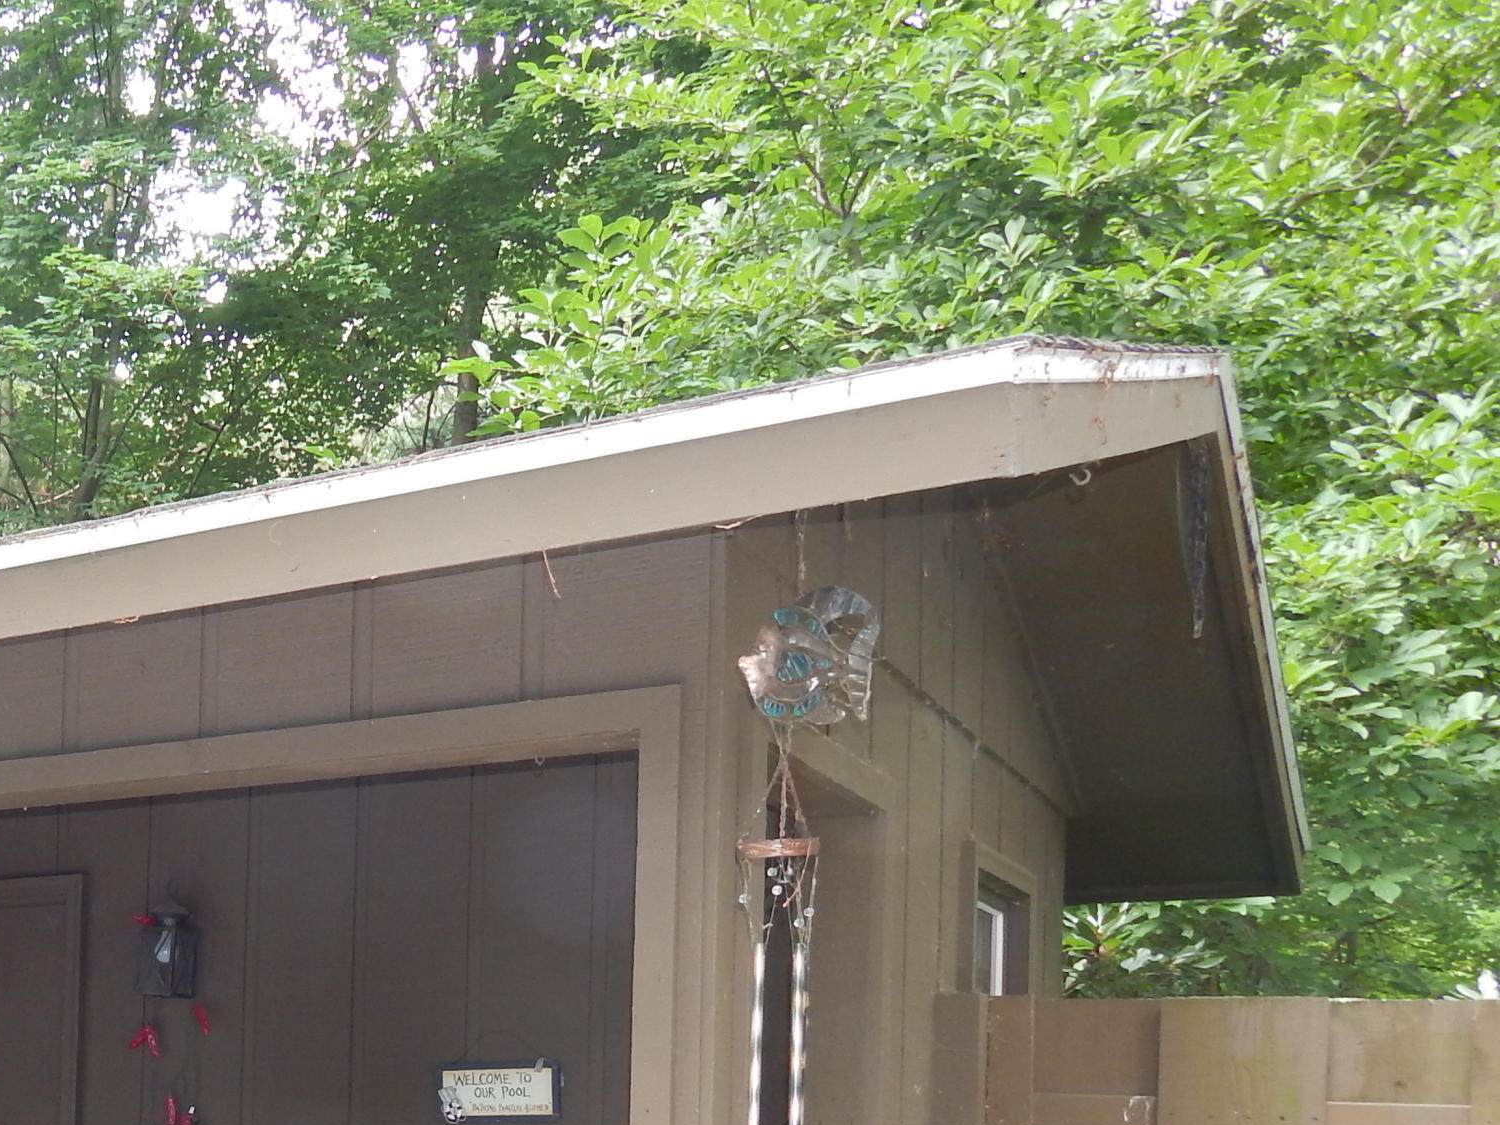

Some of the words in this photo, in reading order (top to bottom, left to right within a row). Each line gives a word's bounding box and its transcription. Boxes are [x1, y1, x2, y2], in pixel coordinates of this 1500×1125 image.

[453, 1072, 512, 1086] WELCOME
[516, 1072, 532, 1084] TO
[474, 1087, 496, 1099] OUR
[501, 1087, 531, 1099] POOL
